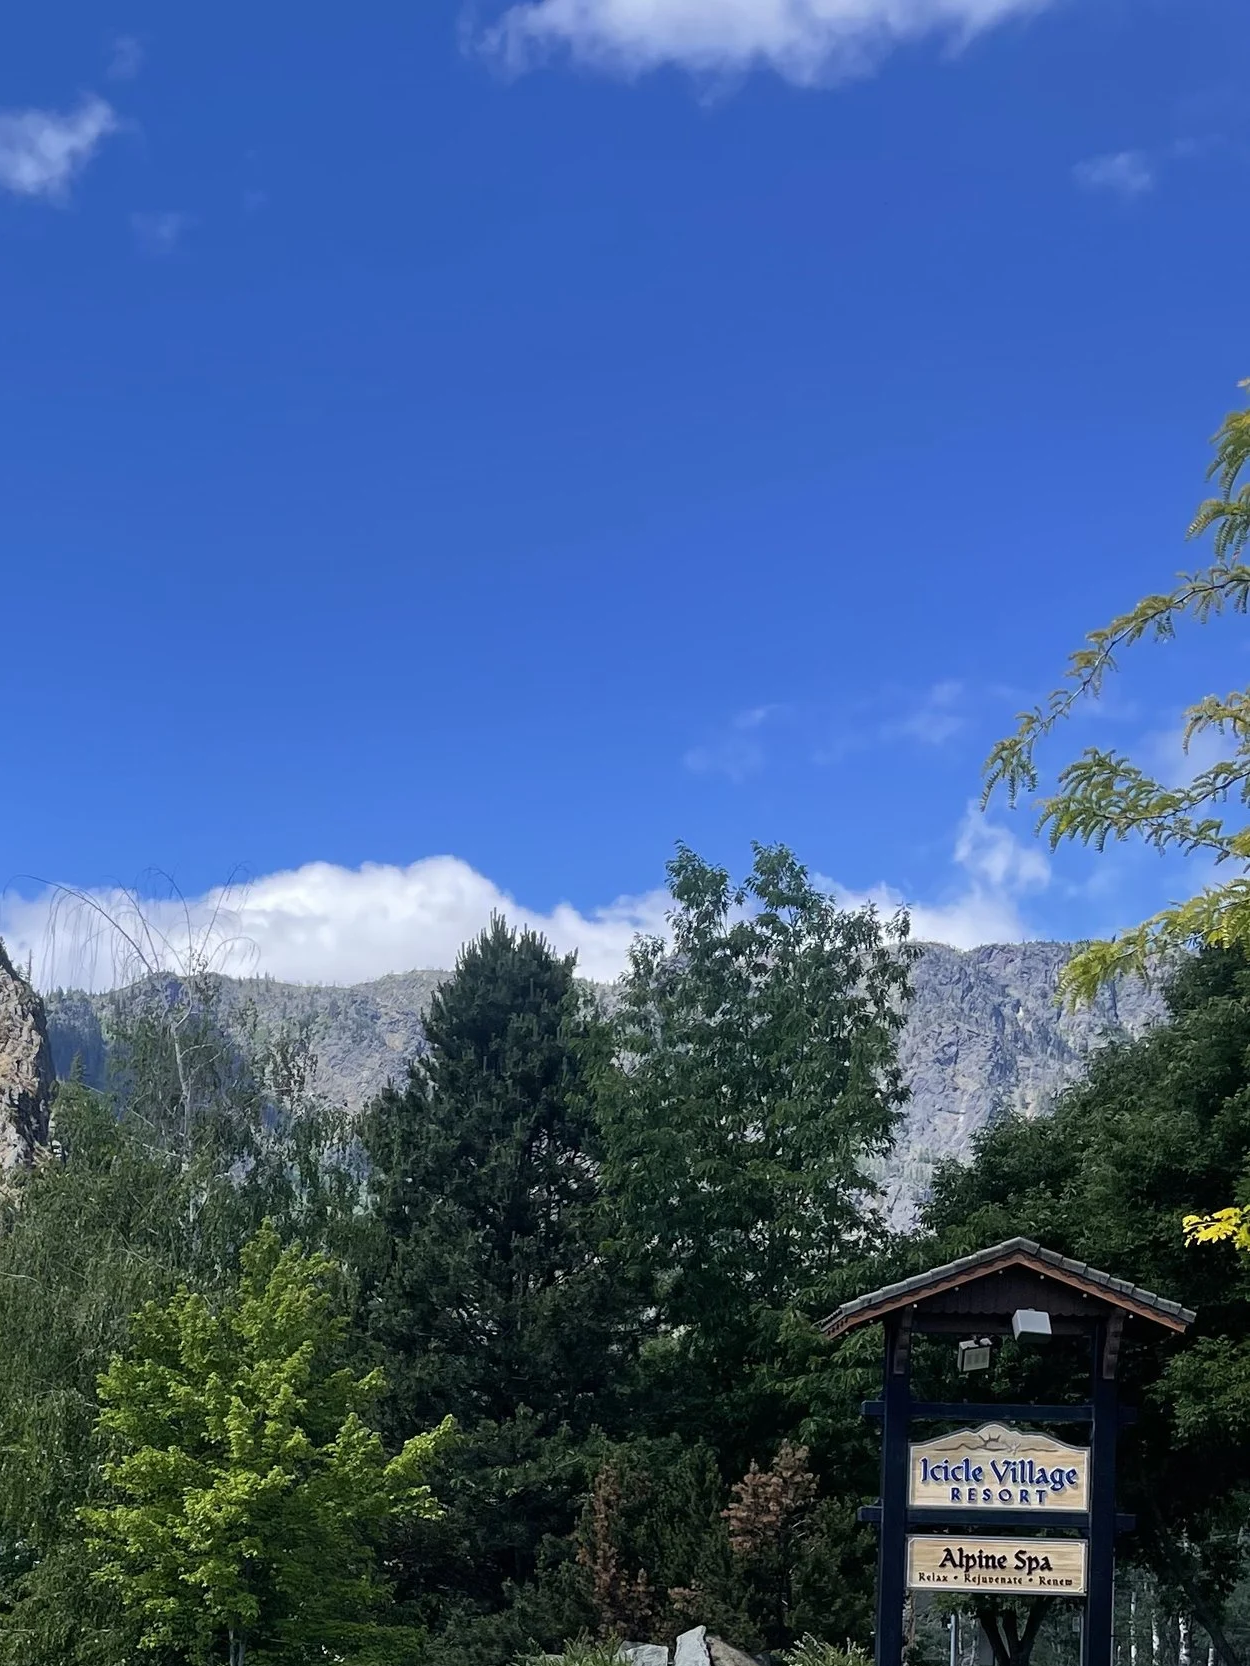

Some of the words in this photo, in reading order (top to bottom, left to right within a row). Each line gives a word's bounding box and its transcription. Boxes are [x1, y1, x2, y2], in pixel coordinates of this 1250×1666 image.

[920, 1457, 983, 1483] Icicle
[989, 1459, 1078, 1492] Village
[951, 1487, 1048, 1503] RESORT
[938, 1547, 1007, 1573] Alpine
[1013, 1550, 1053, 1576] Spa
[918, 1572, 949, 1582] Relax
[964, 1573, 1023, 1585] Rejuvenate
[1039, 1576, 1073, 1586] Renew
